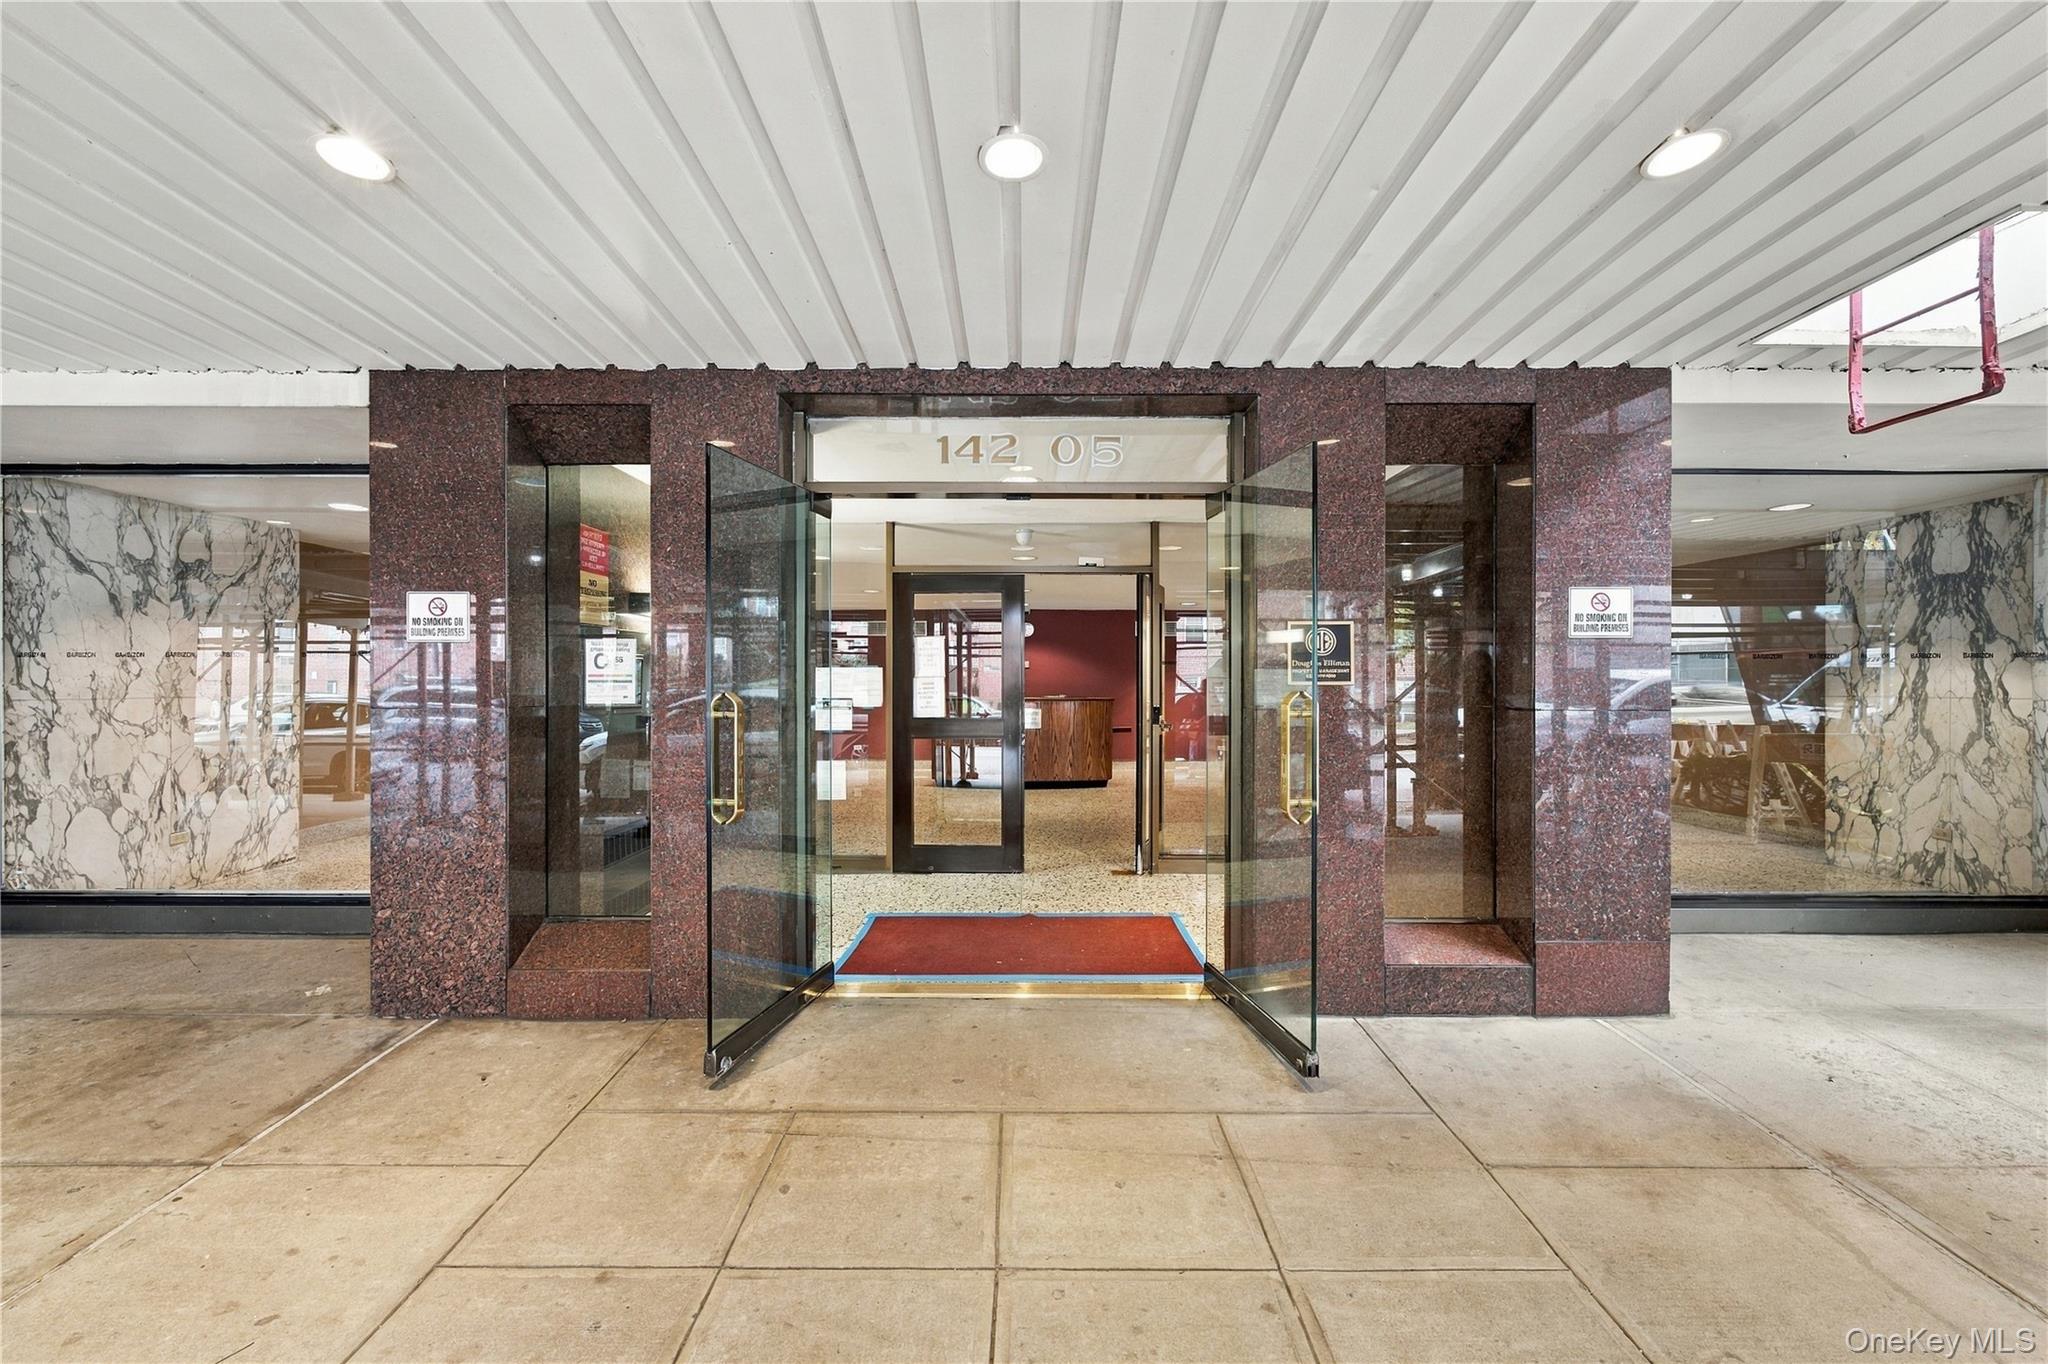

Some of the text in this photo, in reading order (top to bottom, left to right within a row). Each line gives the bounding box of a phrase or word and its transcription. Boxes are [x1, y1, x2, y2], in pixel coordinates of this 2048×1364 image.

[936, 433, 1123, 467] 142 05
[412, 617, 464, 626] NO SMOKING ON
[1574, 613, 1627, 622] NO SMOKING ON
[411, 627, 465, 637] BUILDING PREMISES
[1574, 623, 1629, 633] BUILDING PREMISES
[594, 653, 608, 669] C
[1292, 659, 1322, 669] Dougls
